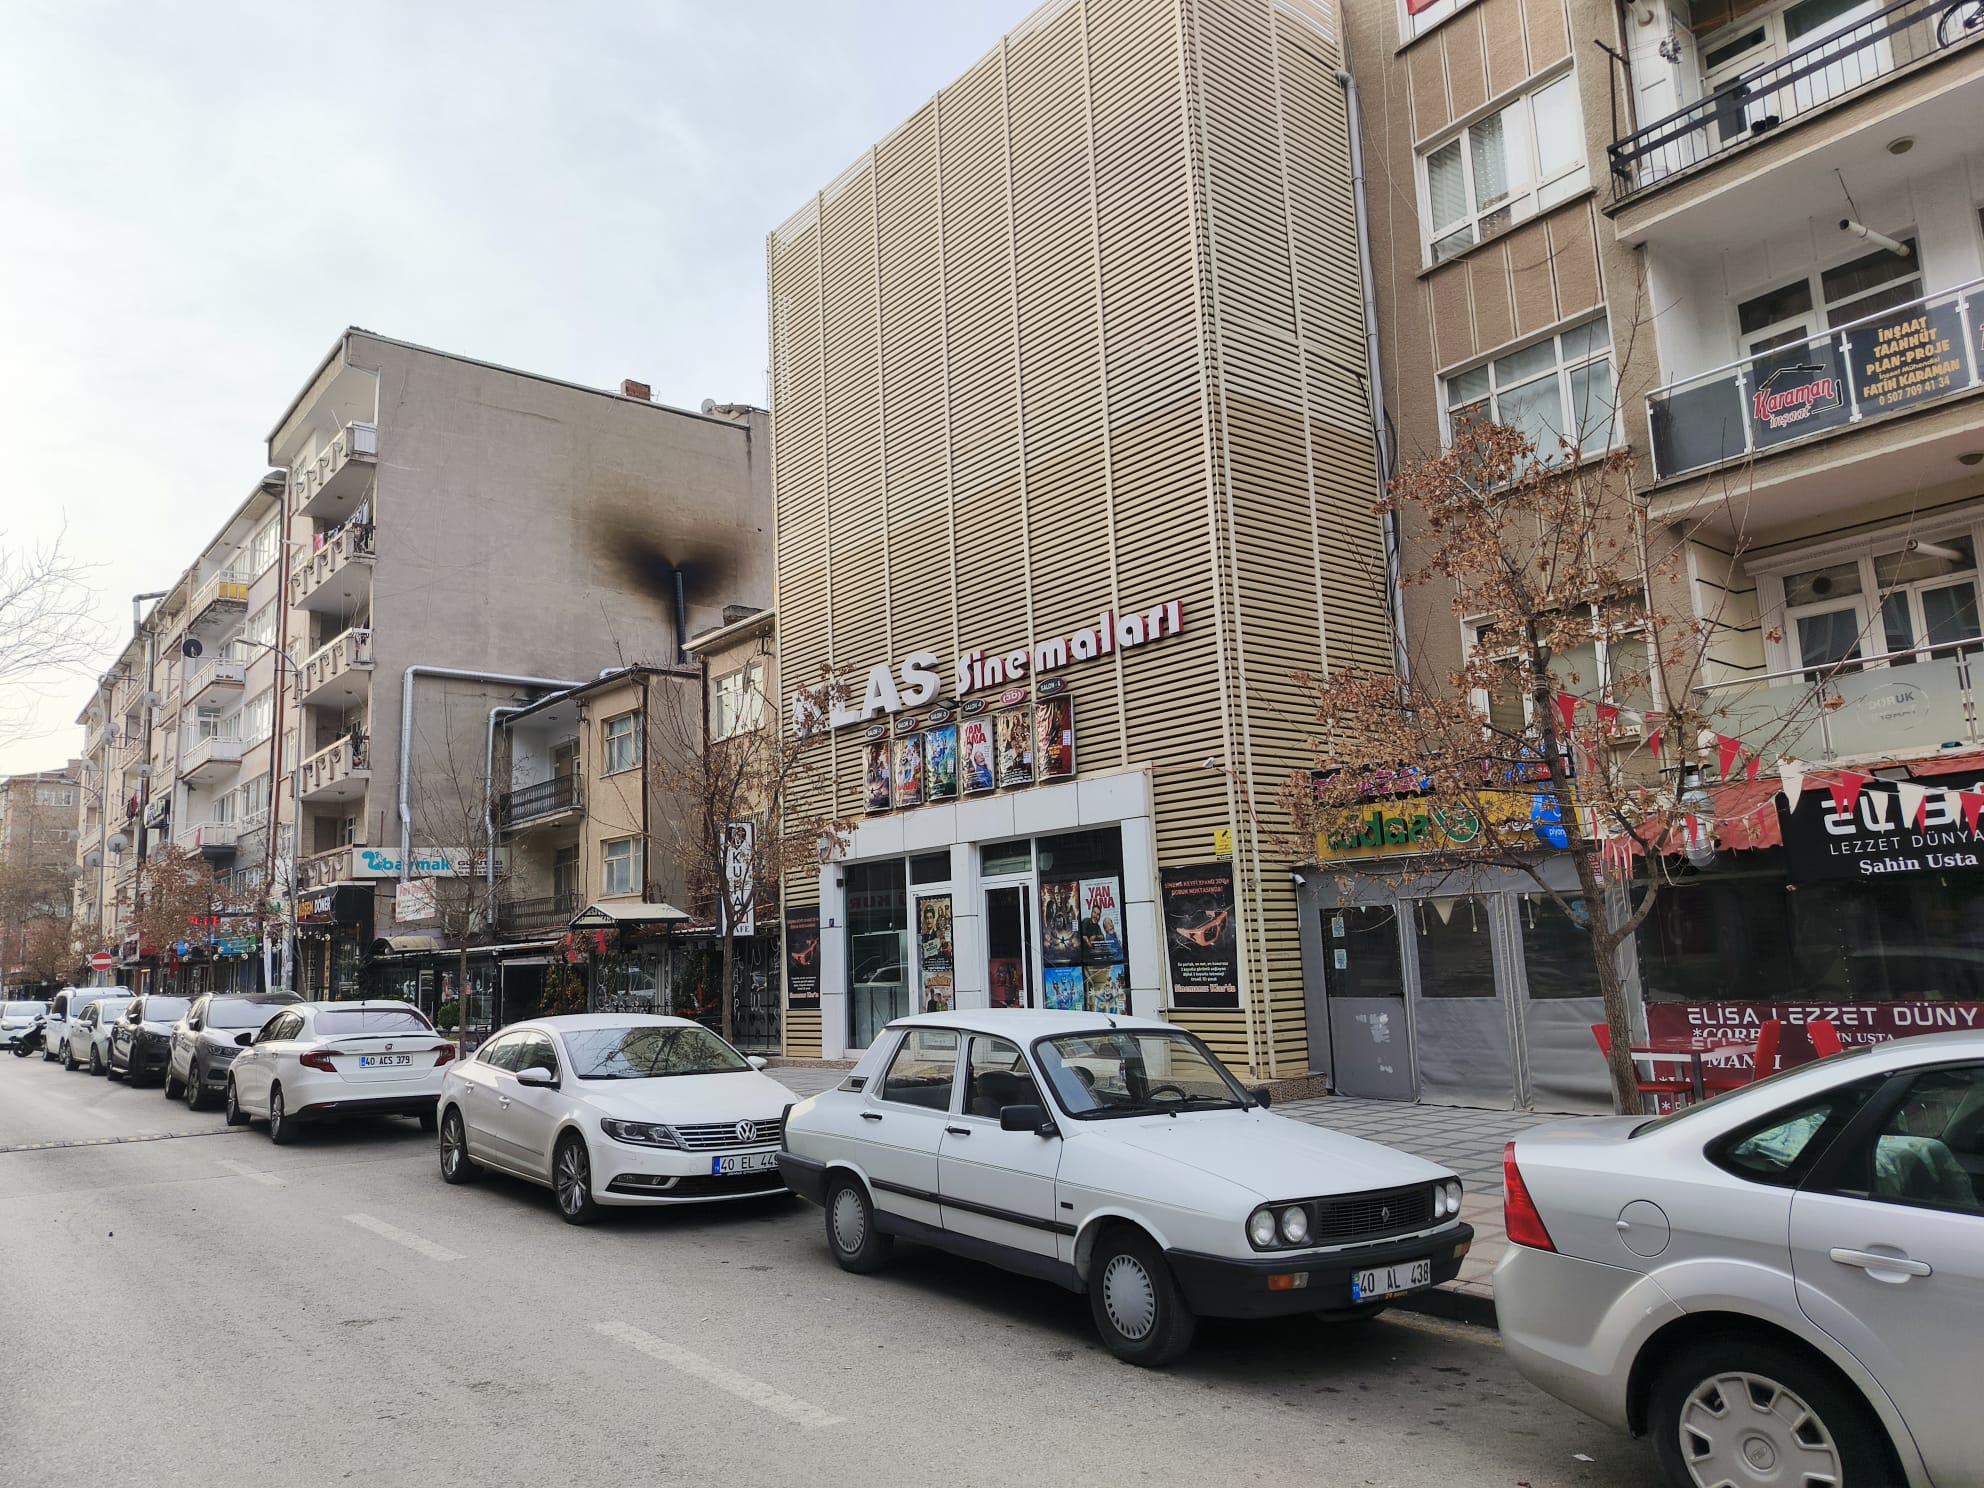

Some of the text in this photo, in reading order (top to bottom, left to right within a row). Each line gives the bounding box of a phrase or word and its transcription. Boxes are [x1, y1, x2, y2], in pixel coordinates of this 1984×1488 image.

[1878, 316, 1927, 342] İNŞAAT
[1873, 328, 1937, 358] TAAHHÜT
[1866, 339, 1950, 375] PLAN-PROJE
[1863, 359, 1960, 397] FATİH KARAMAN
[1753, 378, 1834, 420] Karaman
[1879, 376, 1951, 405] 0 507 709 41 34
[1770, 405, 1812, 429] inşaat
[1829, 836, 1901, 855] LEZZET
[1859, 852, 1978, 875] Şahin Usta
[1086, 897, 1115, 910] YANA
[1088, 886, 1111, 898] YAN
[1687, 1003, 1760, 1025] ELİSA
[1772, 1007, 1878, 1026] LEZZET
[365, 1055, 410, 1066] 40 ACS 379
[721, 1158, 735, 1171] 40
[741, 1156, 755, 1169] EL
[1360, 1262, 1429, 1294] 40 AL 438
